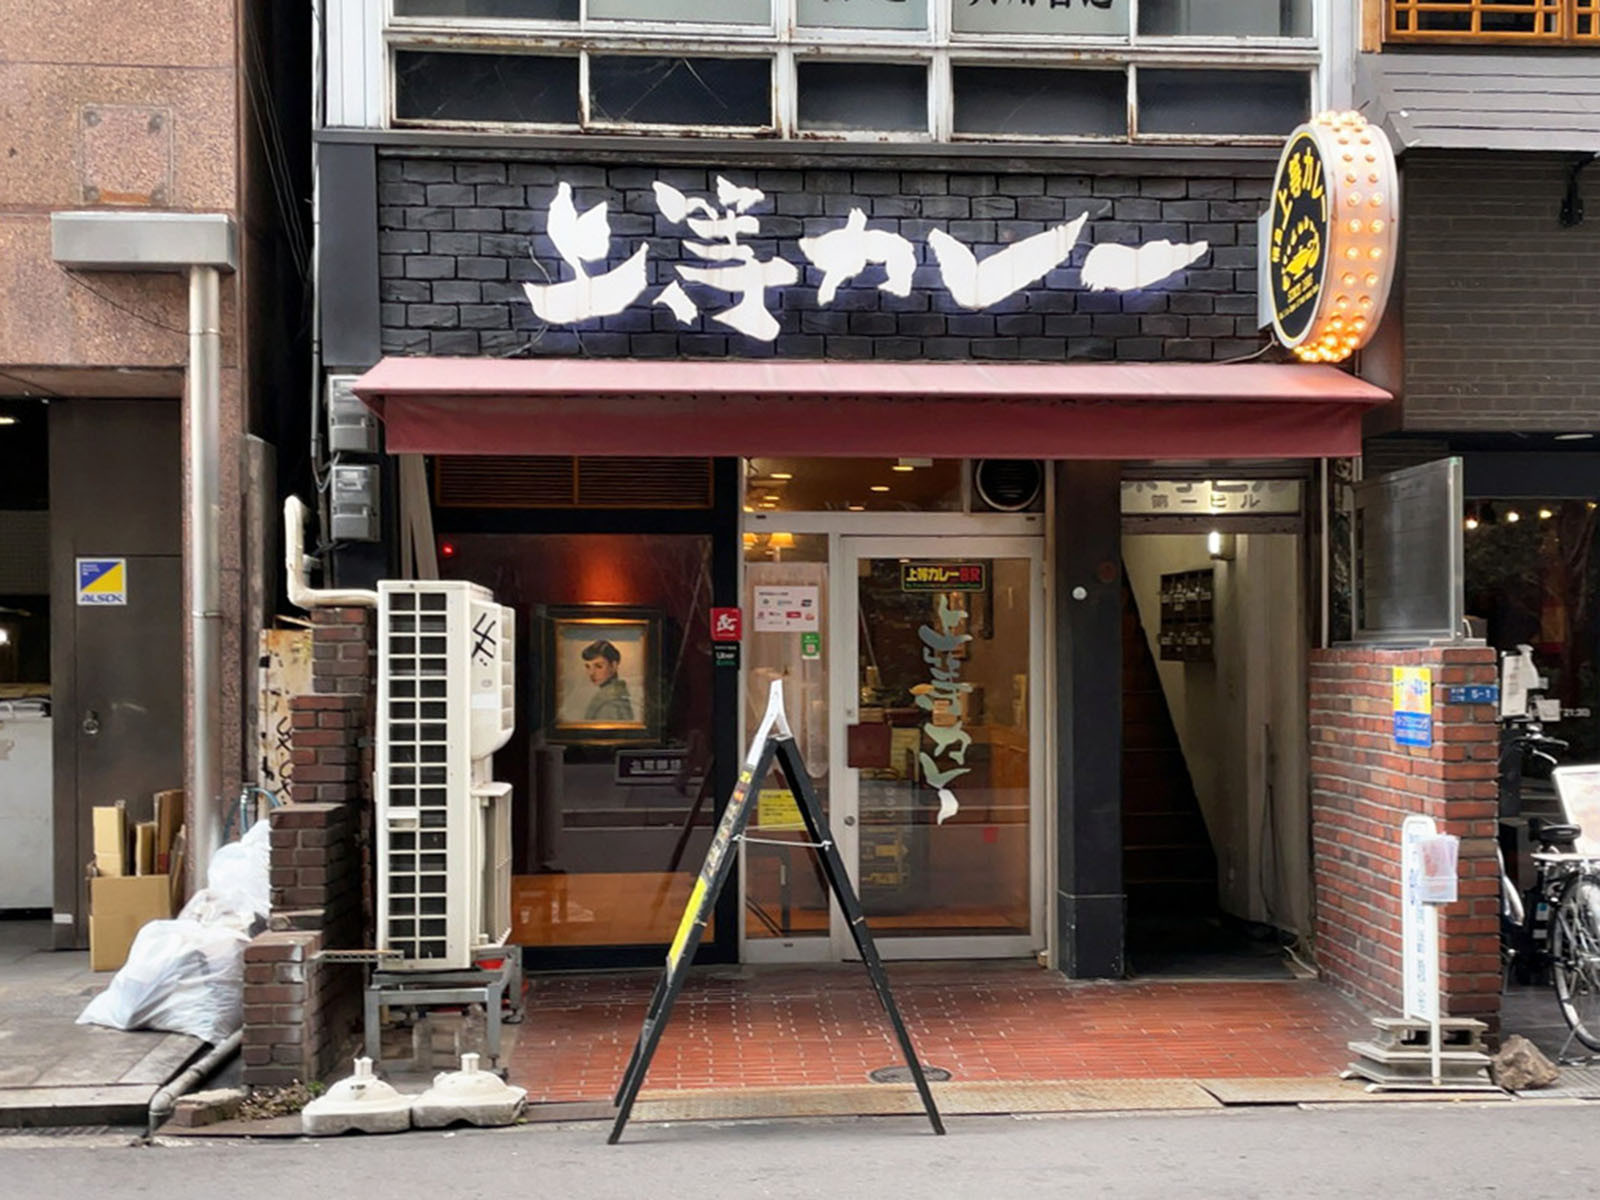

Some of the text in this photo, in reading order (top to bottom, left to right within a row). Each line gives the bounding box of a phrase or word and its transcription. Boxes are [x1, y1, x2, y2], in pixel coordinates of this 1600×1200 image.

[522, 174, 1209, 342] 上等カレー
[909, 594, 974, 826] 上等カレー
